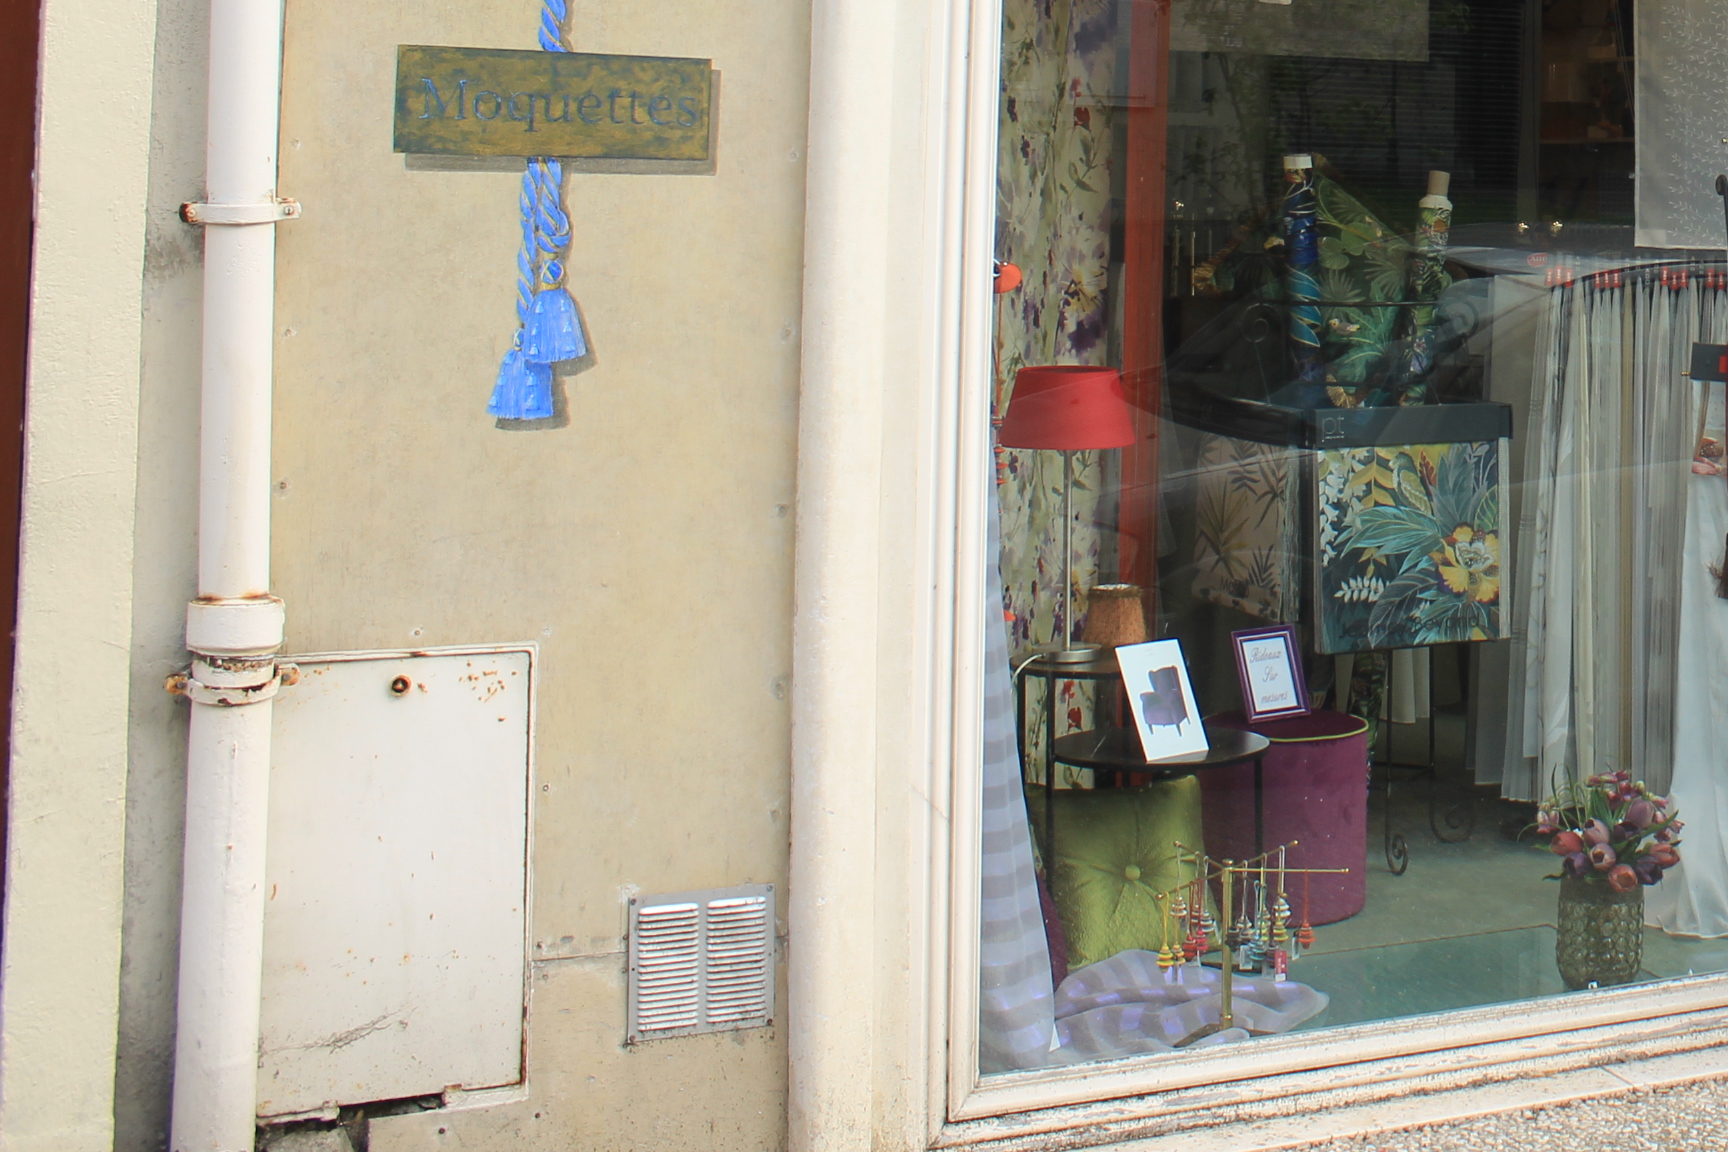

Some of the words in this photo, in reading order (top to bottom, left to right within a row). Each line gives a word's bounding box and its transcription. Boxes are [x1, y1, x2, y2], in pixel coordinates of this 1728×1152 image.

[418, 78, 699, 132] Moquettes
[1249, 647, 1282, 663] Rideaux
[1262, 665, 1279, 682] Sur
[1260, 691, 1288, 703] mesures
